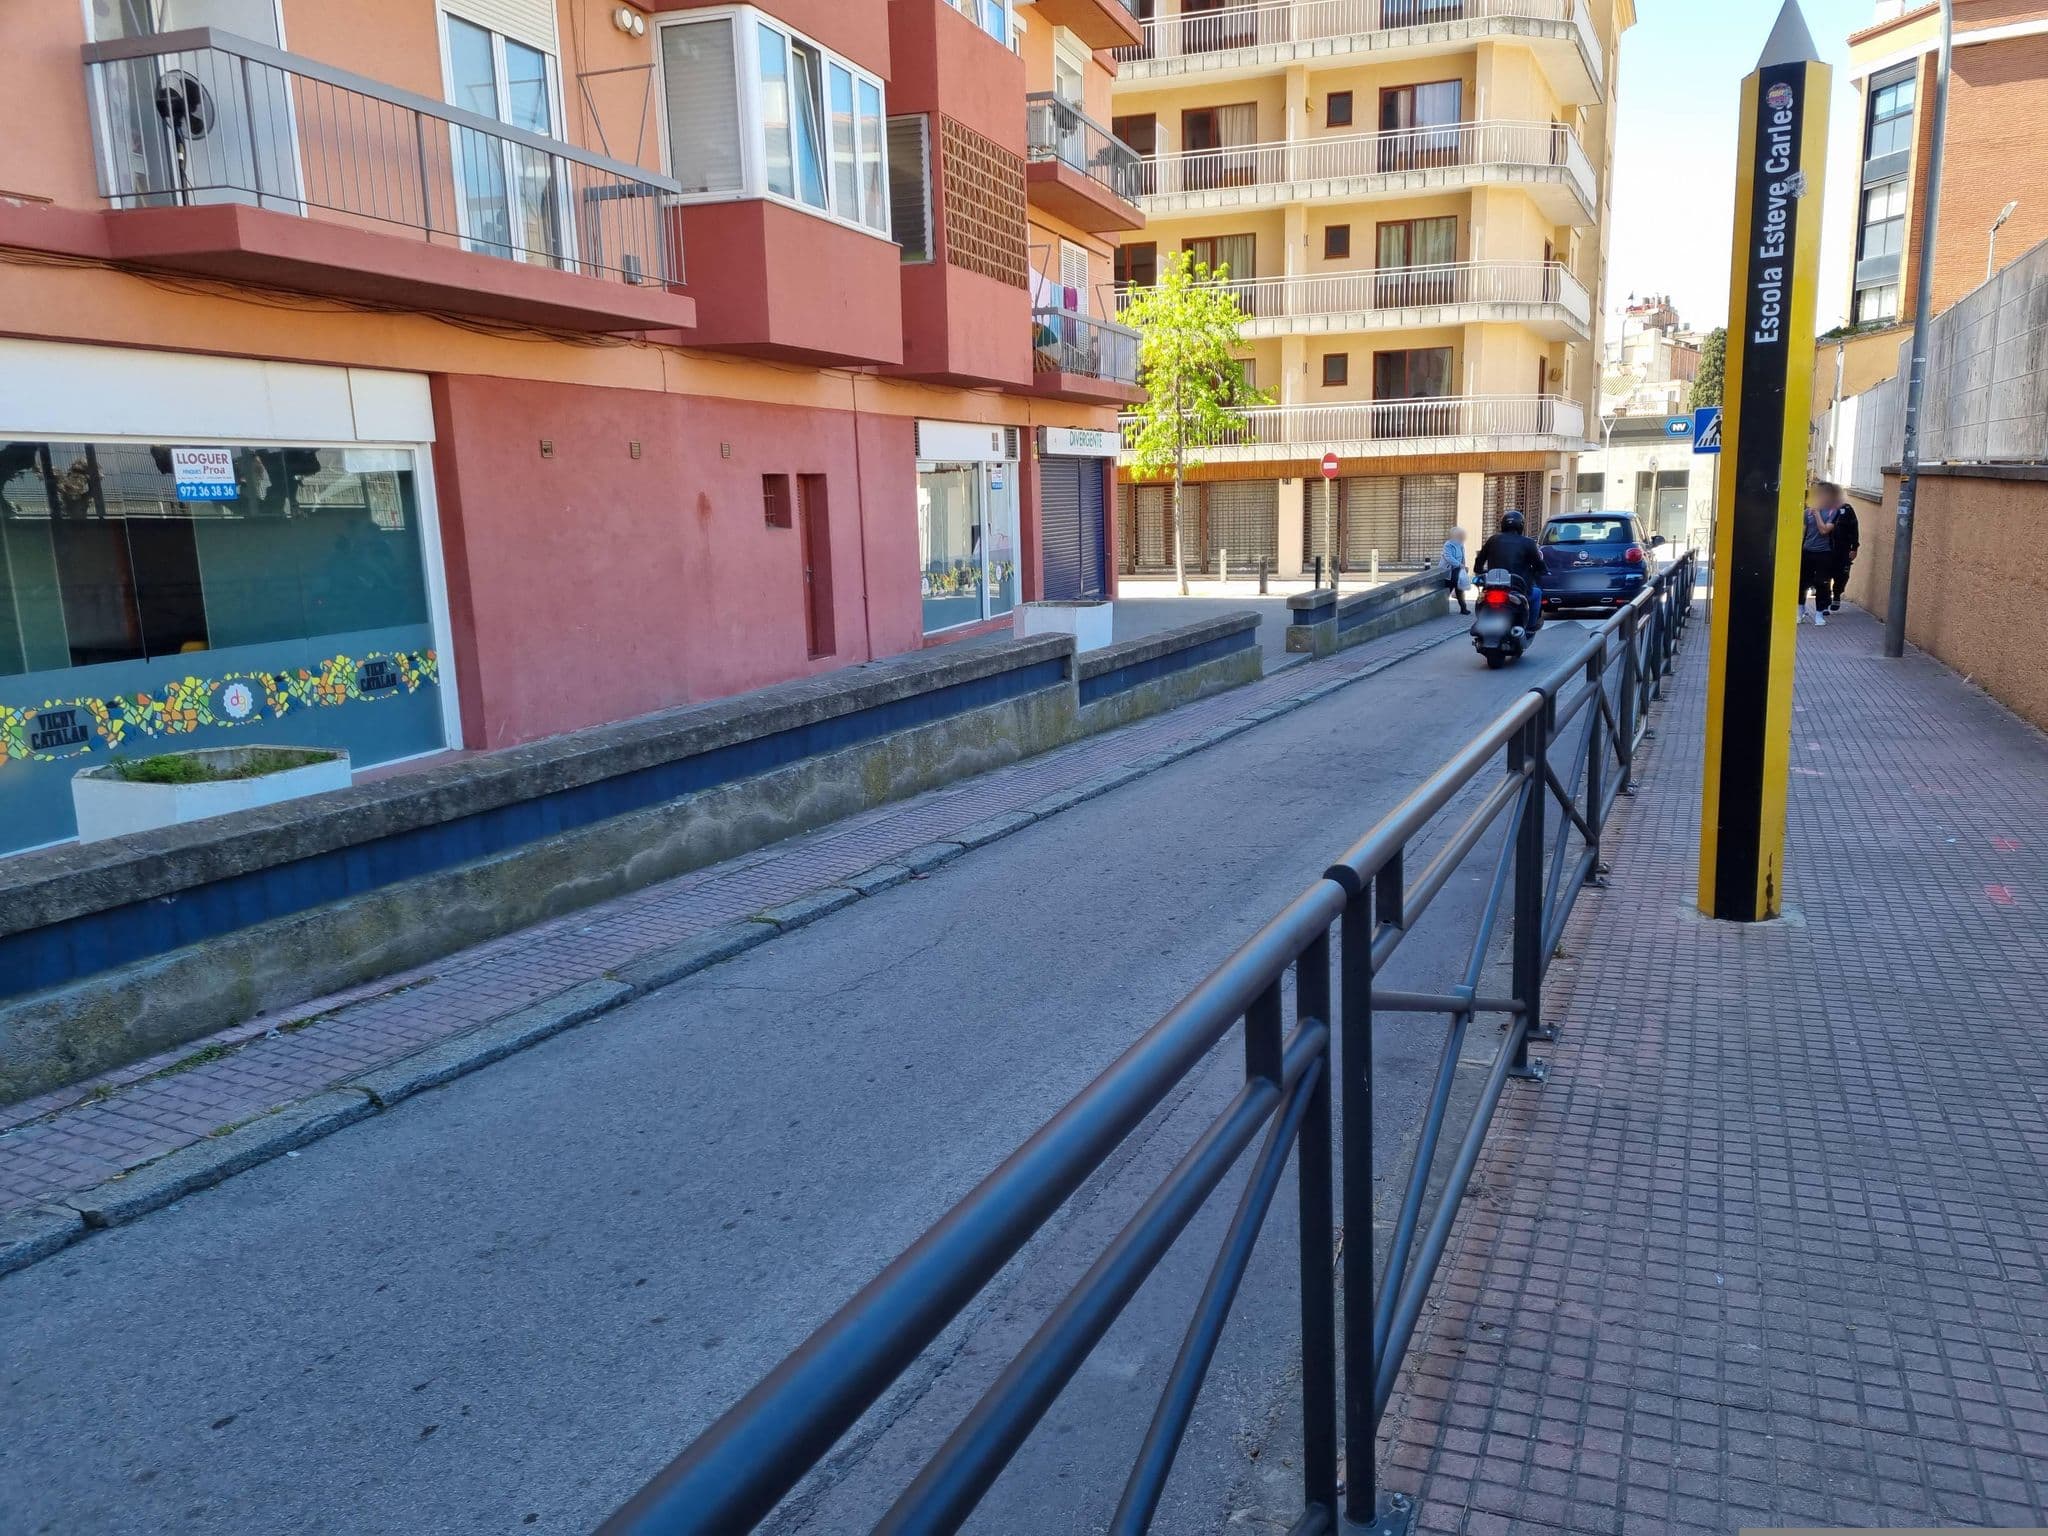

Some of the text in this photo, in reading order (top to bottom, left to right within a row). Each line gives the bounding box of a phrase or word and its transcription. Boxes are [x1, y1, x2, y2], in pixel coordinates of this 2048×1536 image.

[1760, 182, 1788, 259] Esteve
[1754, 266, 1783, 344] Escola
[1069, 430, 1102, 448] DIVERGENTE
[176, 453, 229, 465] LLOGUER
[203, 465, 226, 475] Proa
[180, 485, 234, 497] 972 36 38 36
[38, 709, 77, 731] VICHY
[31, 725, 89, 750] CATALAN
